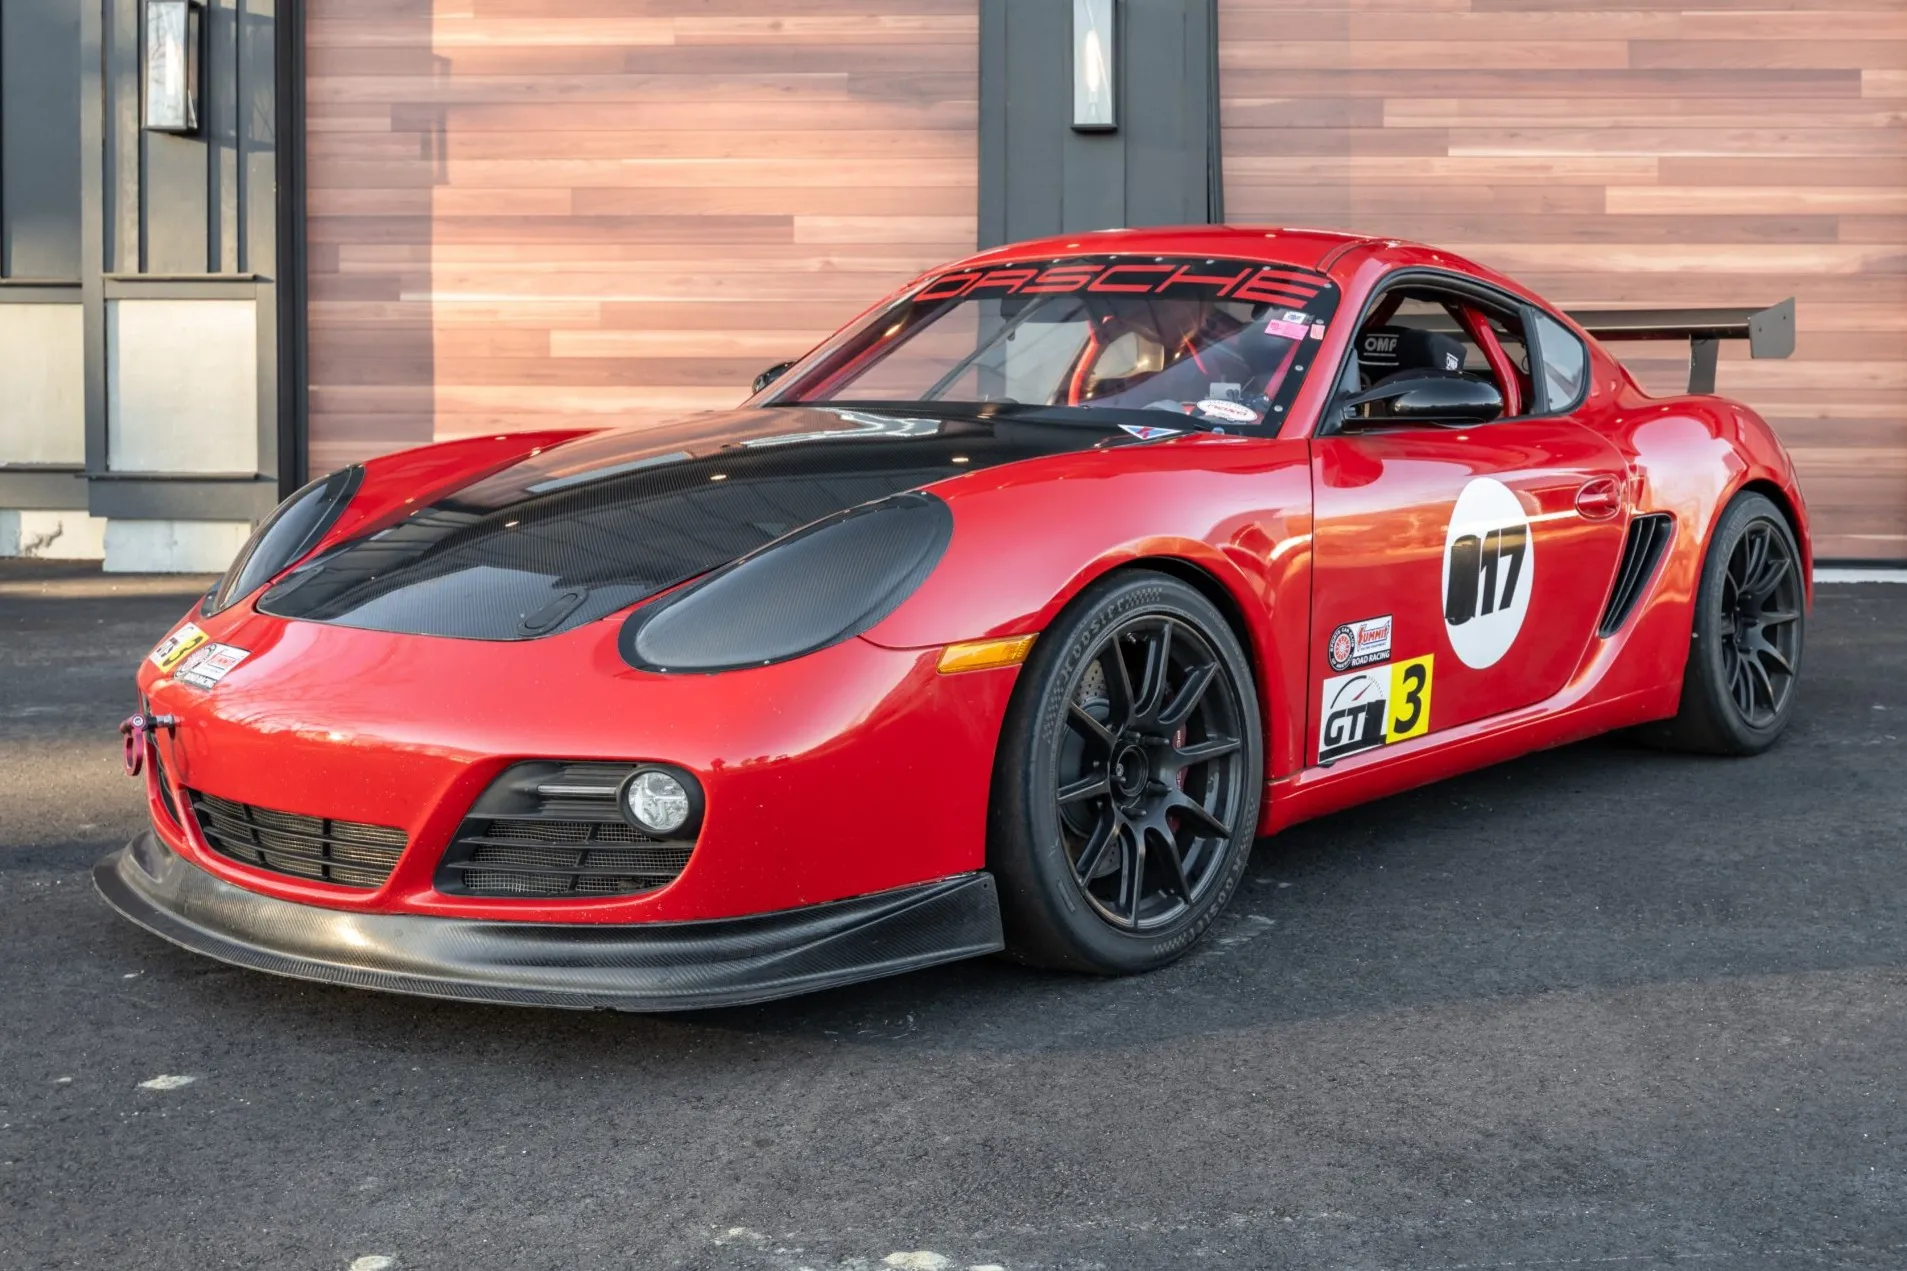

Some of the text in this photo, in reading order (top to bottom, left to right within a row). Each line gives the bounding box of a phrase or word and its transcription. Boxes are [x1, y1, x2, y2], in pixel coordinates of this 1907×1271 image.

[912, 264, 1332, 309] ORSCHE
[1364, 336, 1398, 352] OMP
[1357, 622, 1390, 646] SUMMIT
[1351, 650, 1390, 667] ROAD RACING
[1393, 663, 1426, 734] 3
